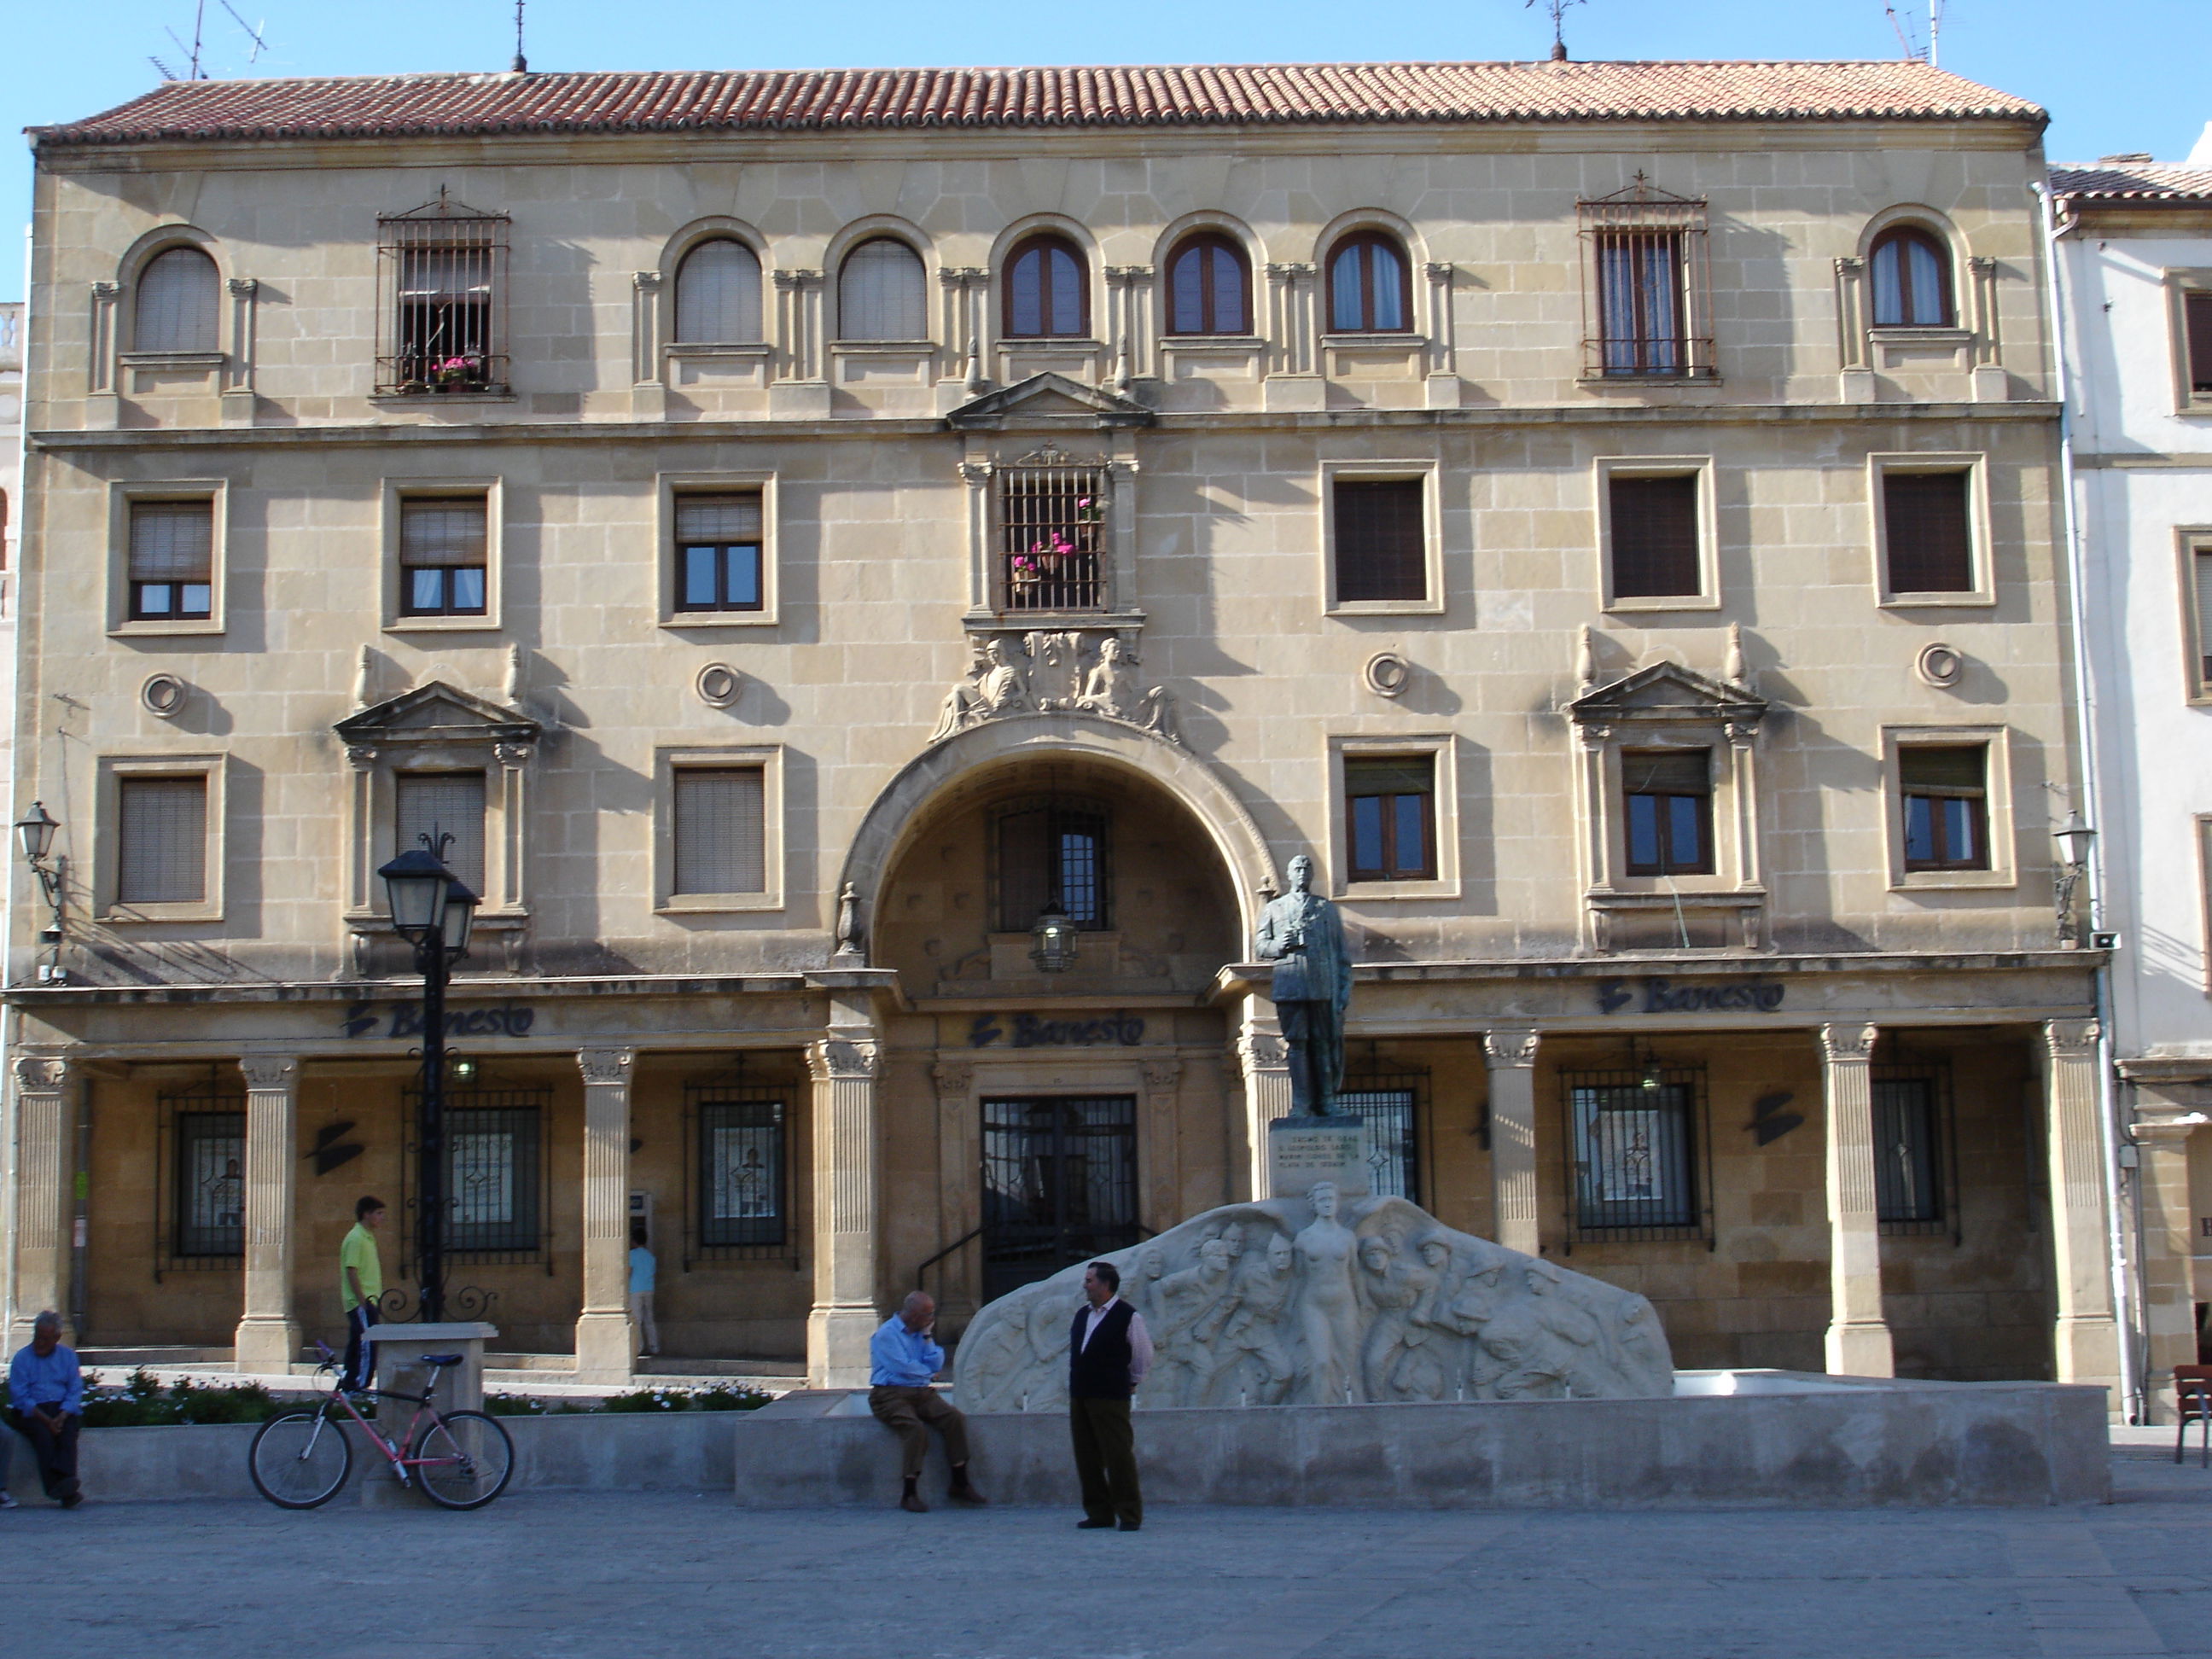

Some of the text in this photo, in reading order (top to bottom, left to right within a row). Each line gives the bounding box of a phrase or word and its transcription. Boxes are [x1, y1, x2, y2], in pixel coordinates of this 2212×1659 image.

[1642, 976, 1785, 1013] Banesto
[388, 1001, 536, 1039] Bnesto
[1010, 1010, 1146, 1048] Banesto
